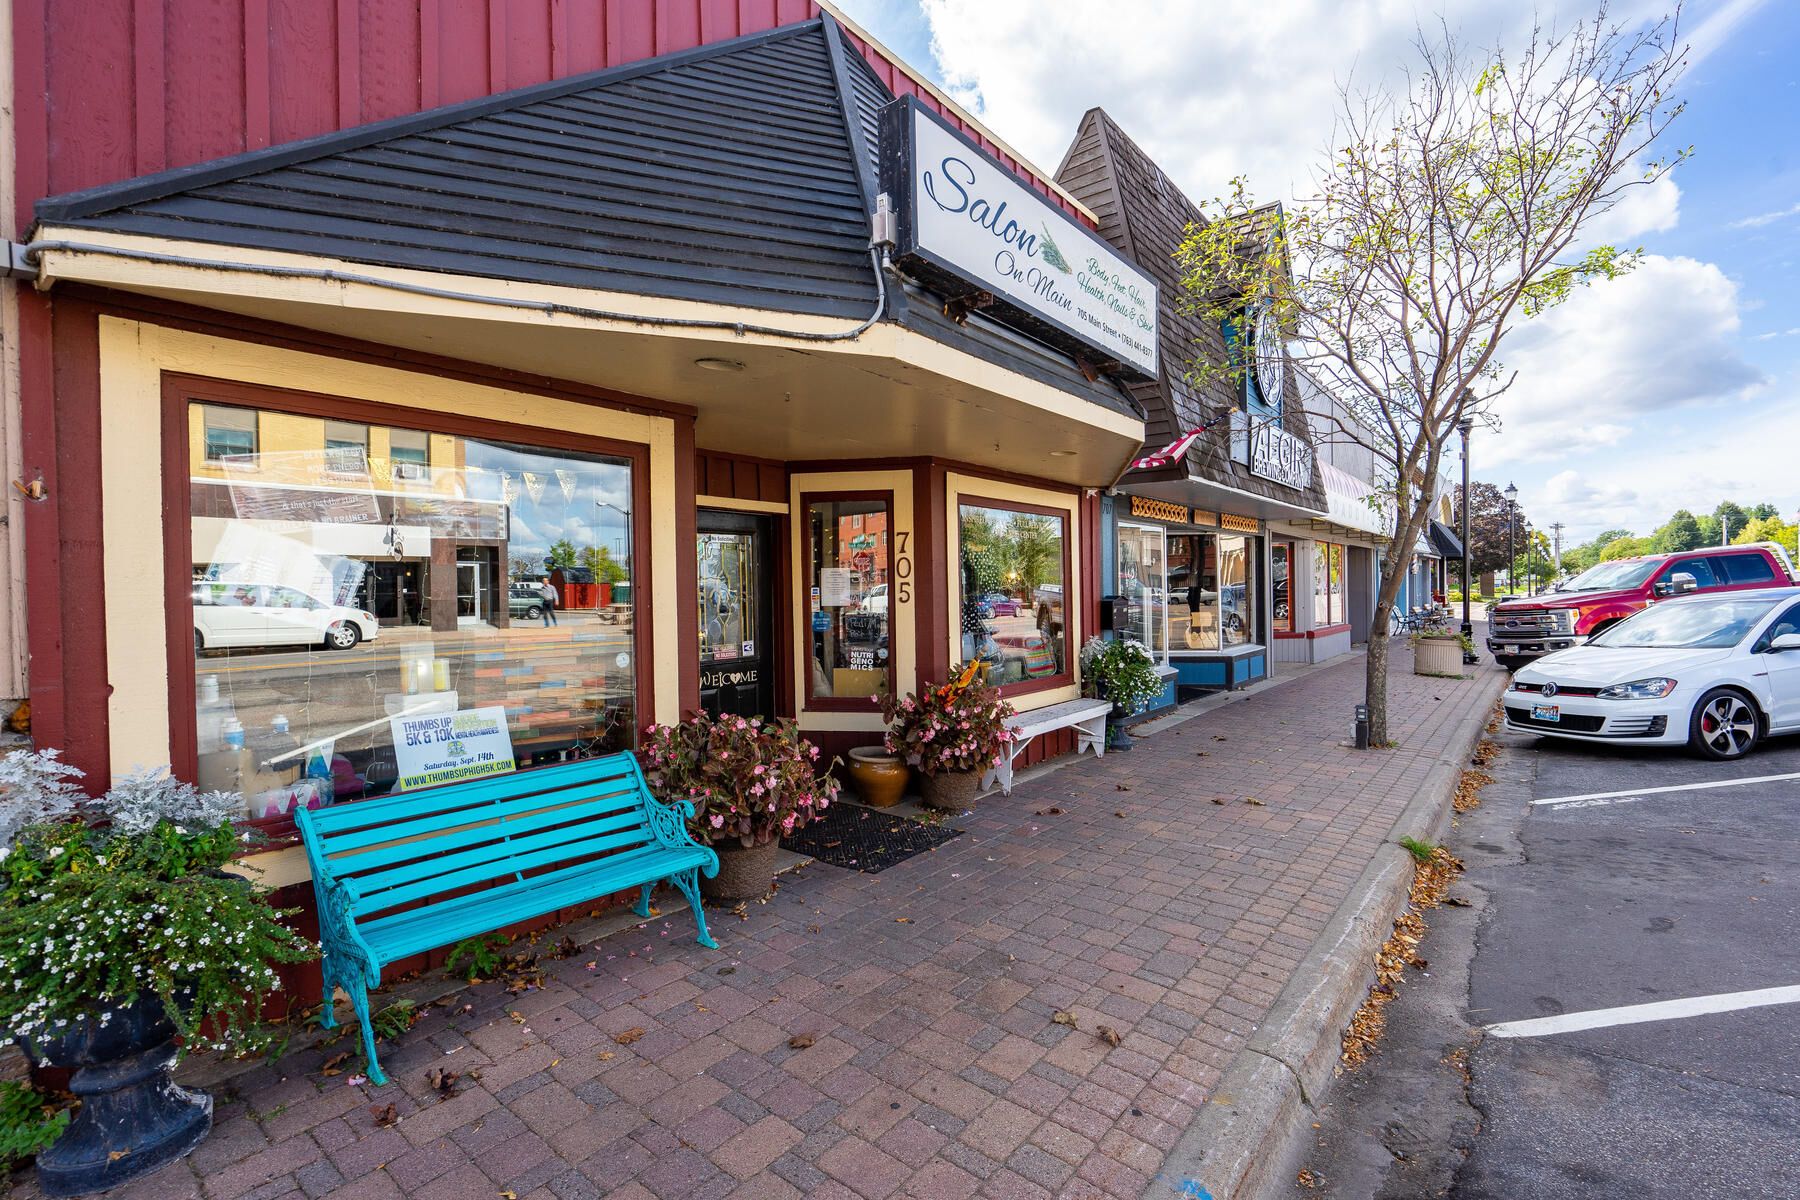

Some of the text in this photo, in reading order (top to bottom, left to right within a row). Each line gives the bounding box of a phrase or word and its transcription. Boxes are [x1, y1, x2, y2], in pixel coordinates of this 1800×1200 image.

[924, 157, 1038, 257] Salon
[995, 250, 1072, 311] On Main
[1107, 294, 1128, 317] Nails
[1129, 308, 1136, 320] &
[1077, 308, 1087, 321] 705
[1088, 314, 1101, 330] Main
[1102, 322, 1117, 339] Street
[1121, 334, 1133, 348] (763)
[332, 462, 364, 472] ENERGY
[1254, 457, 1303, 488] BREWING COMPANY
[333, 512, 368, 523] BRAINER
[1102, 503, 1113, 515] 707
[896, 531, 912, 603] 705
[850, 651, 874, 659] NUTRI
[402, 716, 452, 733] THUMBS UP
[405, 727, 455, 747] 5K & 10K
[460, 756, 477, 766] Sept.
[477, 751, 494, 762] 14th
[404, 760, 513, 788] WWW.THUMBSUPHIGH5K.COM
